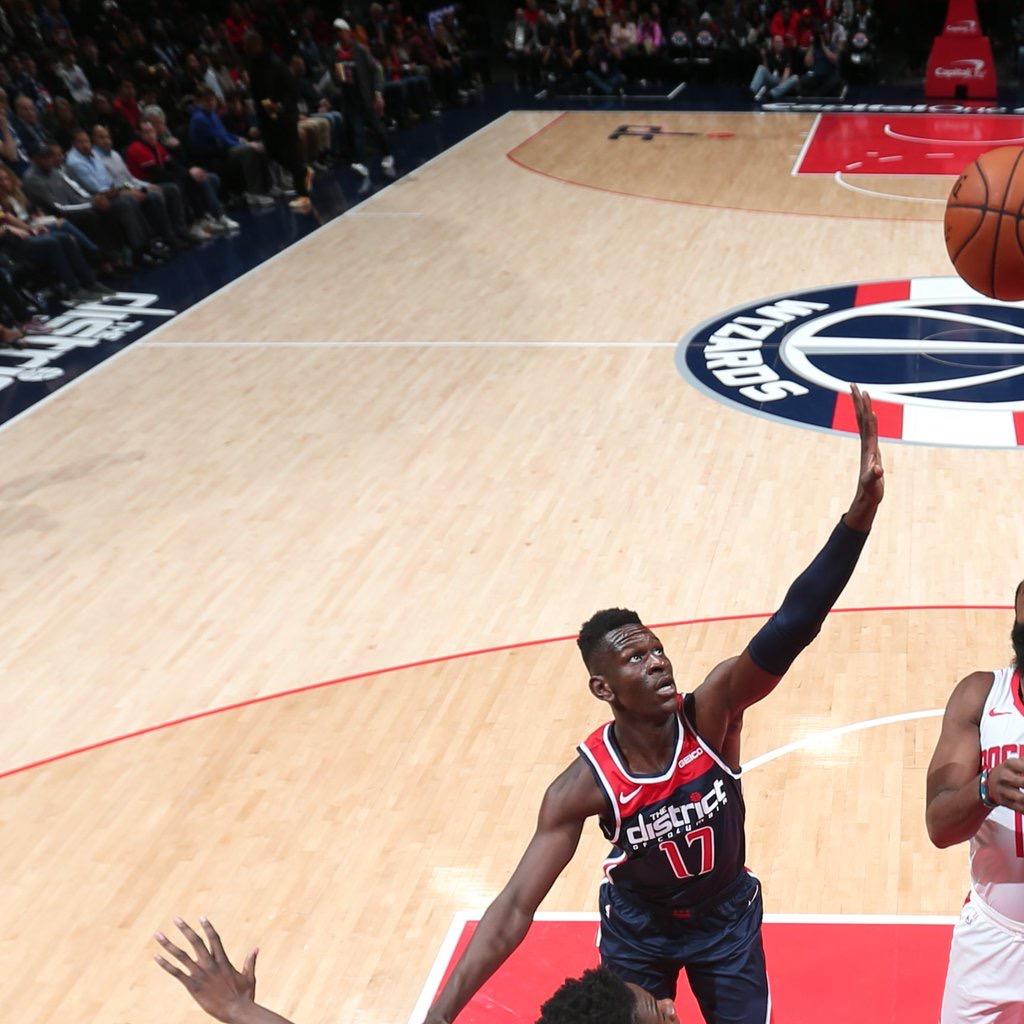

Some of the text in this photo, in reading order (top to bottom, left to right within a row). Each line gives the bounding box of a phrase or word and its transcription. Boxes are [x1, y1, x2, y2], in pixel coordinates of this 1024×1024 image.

[703, 299, 829, 402] WIZARDS
[626, 779, 727, 845] district
[650, 805, 668, 821] THE
[659, 826, 715, 879] 17
